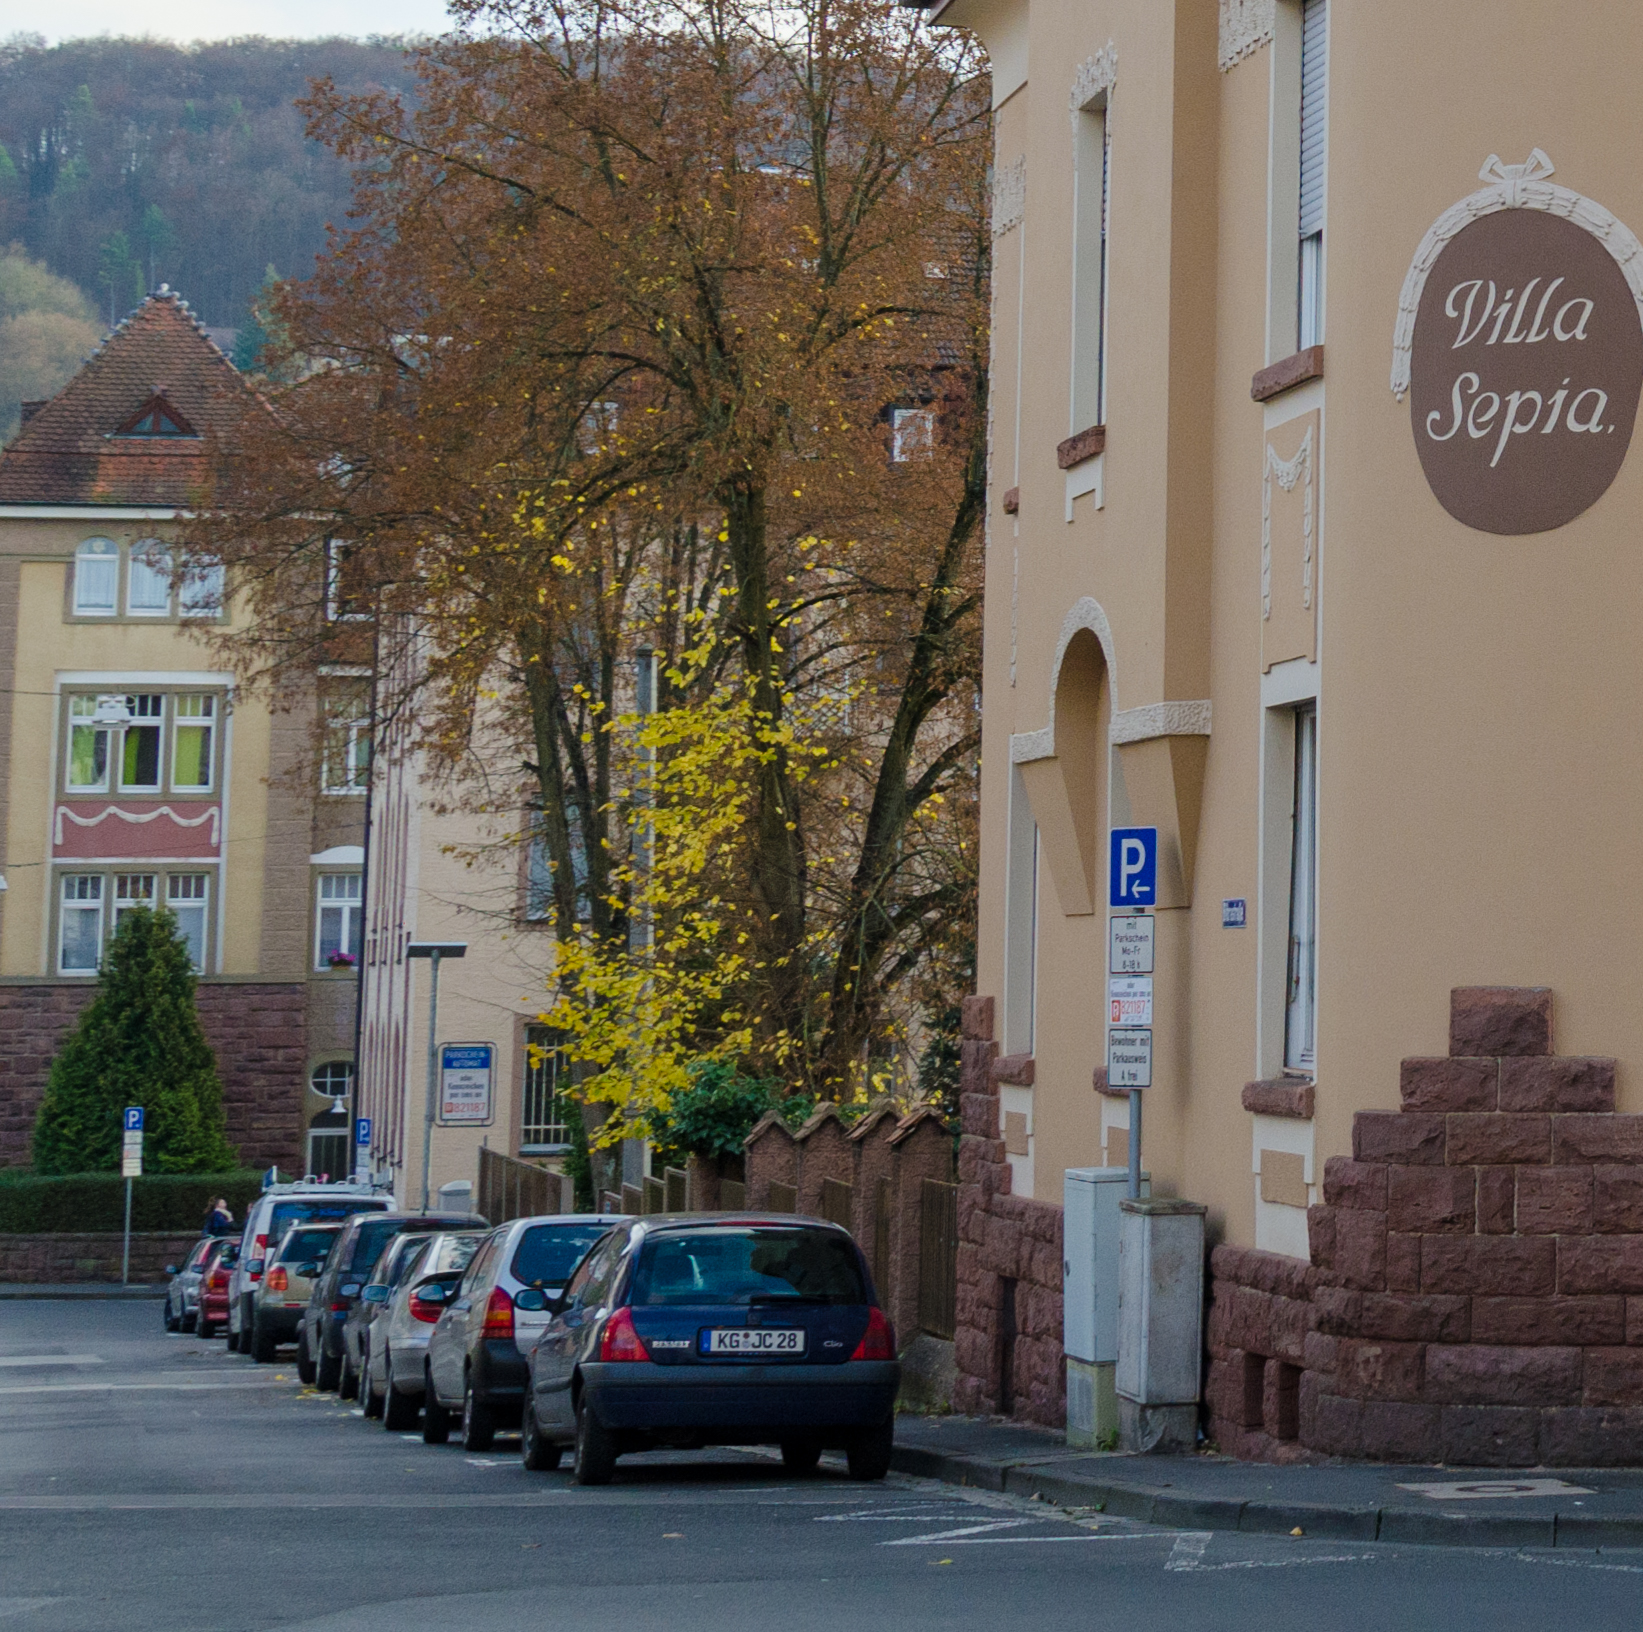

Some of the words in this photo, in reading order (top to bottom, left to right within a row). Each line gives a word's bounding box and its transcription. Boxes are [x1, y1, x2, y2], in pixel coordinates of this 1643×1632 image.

[1445, 277, 1593, 349] Villa
[1120, 838, 1146, 897] P
[1115, 933, 1150, 943] Parkschein
[1111, 1035, 1137, 1046] Bewohner
[1112, 1052, 1147, 1064] Parkausweis
[454, 1102, 485, 1112] 821187
[128, 1110, 140, 1128] P
[360, 1121, 368, 1142] P
[718, 1333, 740, 1349] KG
[751, 1333, 773, 1349] JC
[777, 1333, 797, 1349] 28
